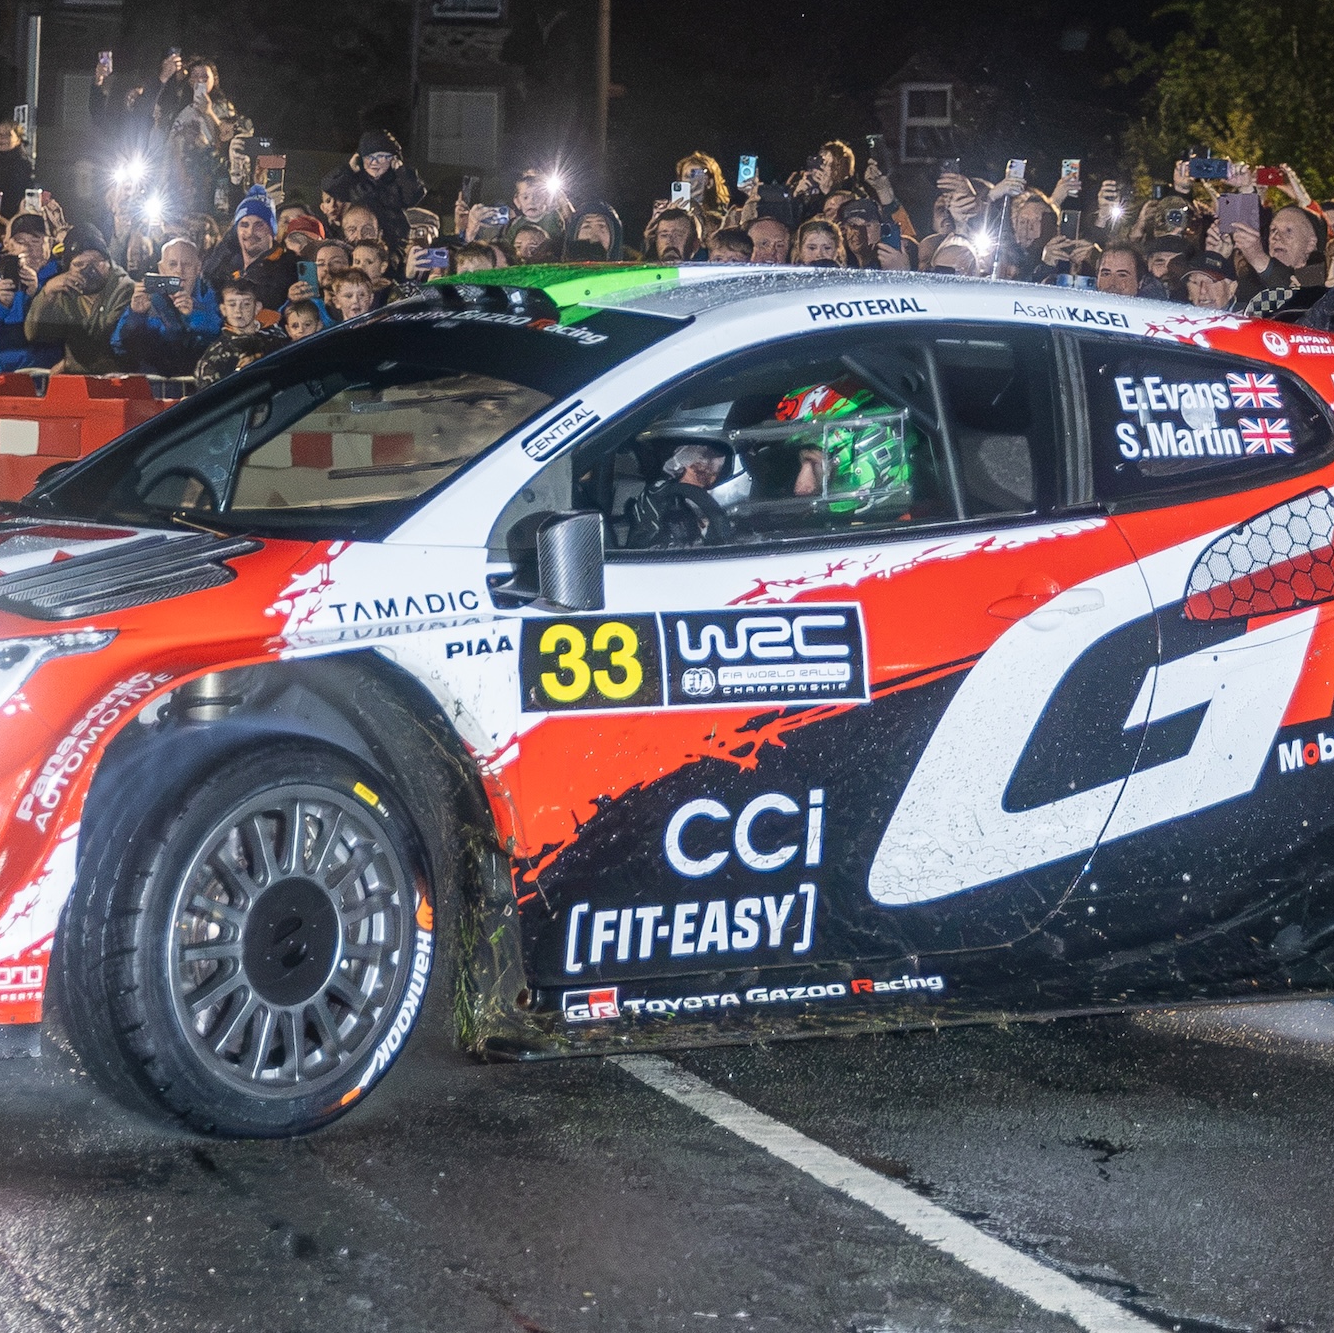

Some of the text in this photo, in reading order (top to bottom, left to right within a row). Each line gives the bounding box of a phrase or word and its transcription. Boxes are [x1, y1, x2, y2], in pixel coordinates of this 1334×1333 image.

[806, 298, 927, 321] PROTERIAL
[1013, 301, 1130, 328] AsahiKASEI
[526, 318, 609, 345] Racing
[1289, 335, 1329, 344] JAPAN
[1114, 377, 1231, 411] E.Evans
[524, 407, 594, 459] CENTRAL
[1116, 422, 1243, 458] S.Martin
[329, 589, 479, 623] TAMADIC
[446, 635, 514, 659] PIAA
[676, 615, 850, 661] WRC
[539, 622, 643, 702] 33
[722, 668, 846, 679] FIA WORLD RALLY
[722, 682, 847, 694] CHAMPIONSHIP
[16, 672, 151, 822] Panasonic
[35, 673, 173, 834] AUTOMOTIVE
[568, 1003, 615, 1017] GR
[624, 975, 942, 1013] TOYOTA GAZOO Racing
